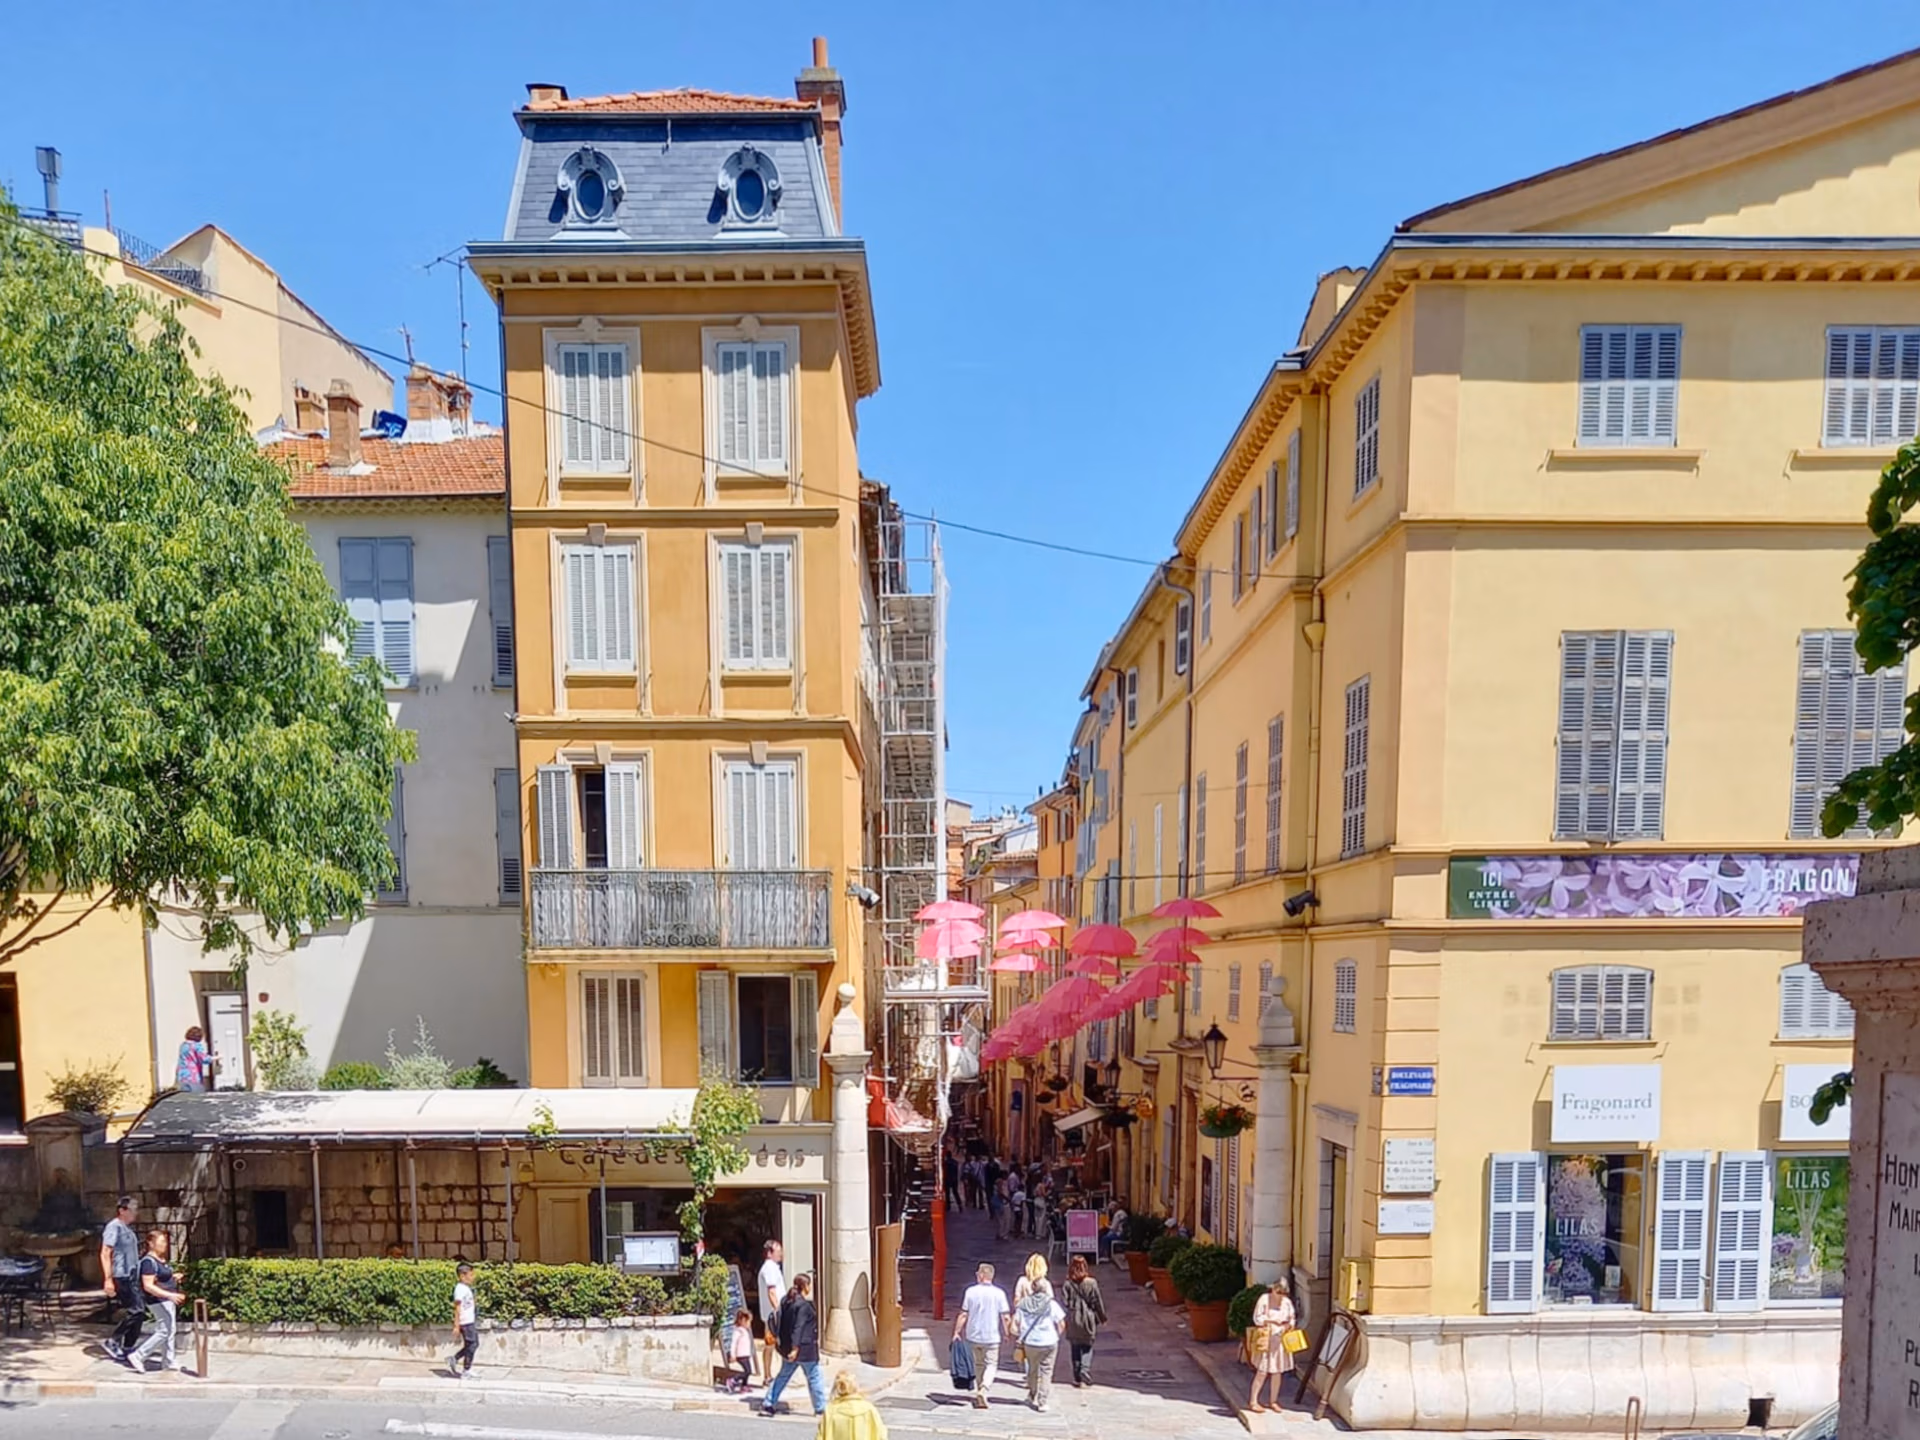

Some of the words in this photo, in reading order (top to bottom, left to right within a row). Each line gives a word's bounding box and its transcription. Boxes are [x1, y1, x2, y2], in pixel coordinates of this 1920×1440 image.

[1482, 871, 1502, 887] ICI
[1760, 867, 1857, 891] FRAGON
[1468, 888, 1516, 900] ENTRÉE
[1473, 900, 1510, 909] LIBRE
[1561, 1091, 1653, 1114] Fragonard
[1786, 1170, 1831, 1189] LILAS
[1555, 1217, 1598, 1236] LILAS
